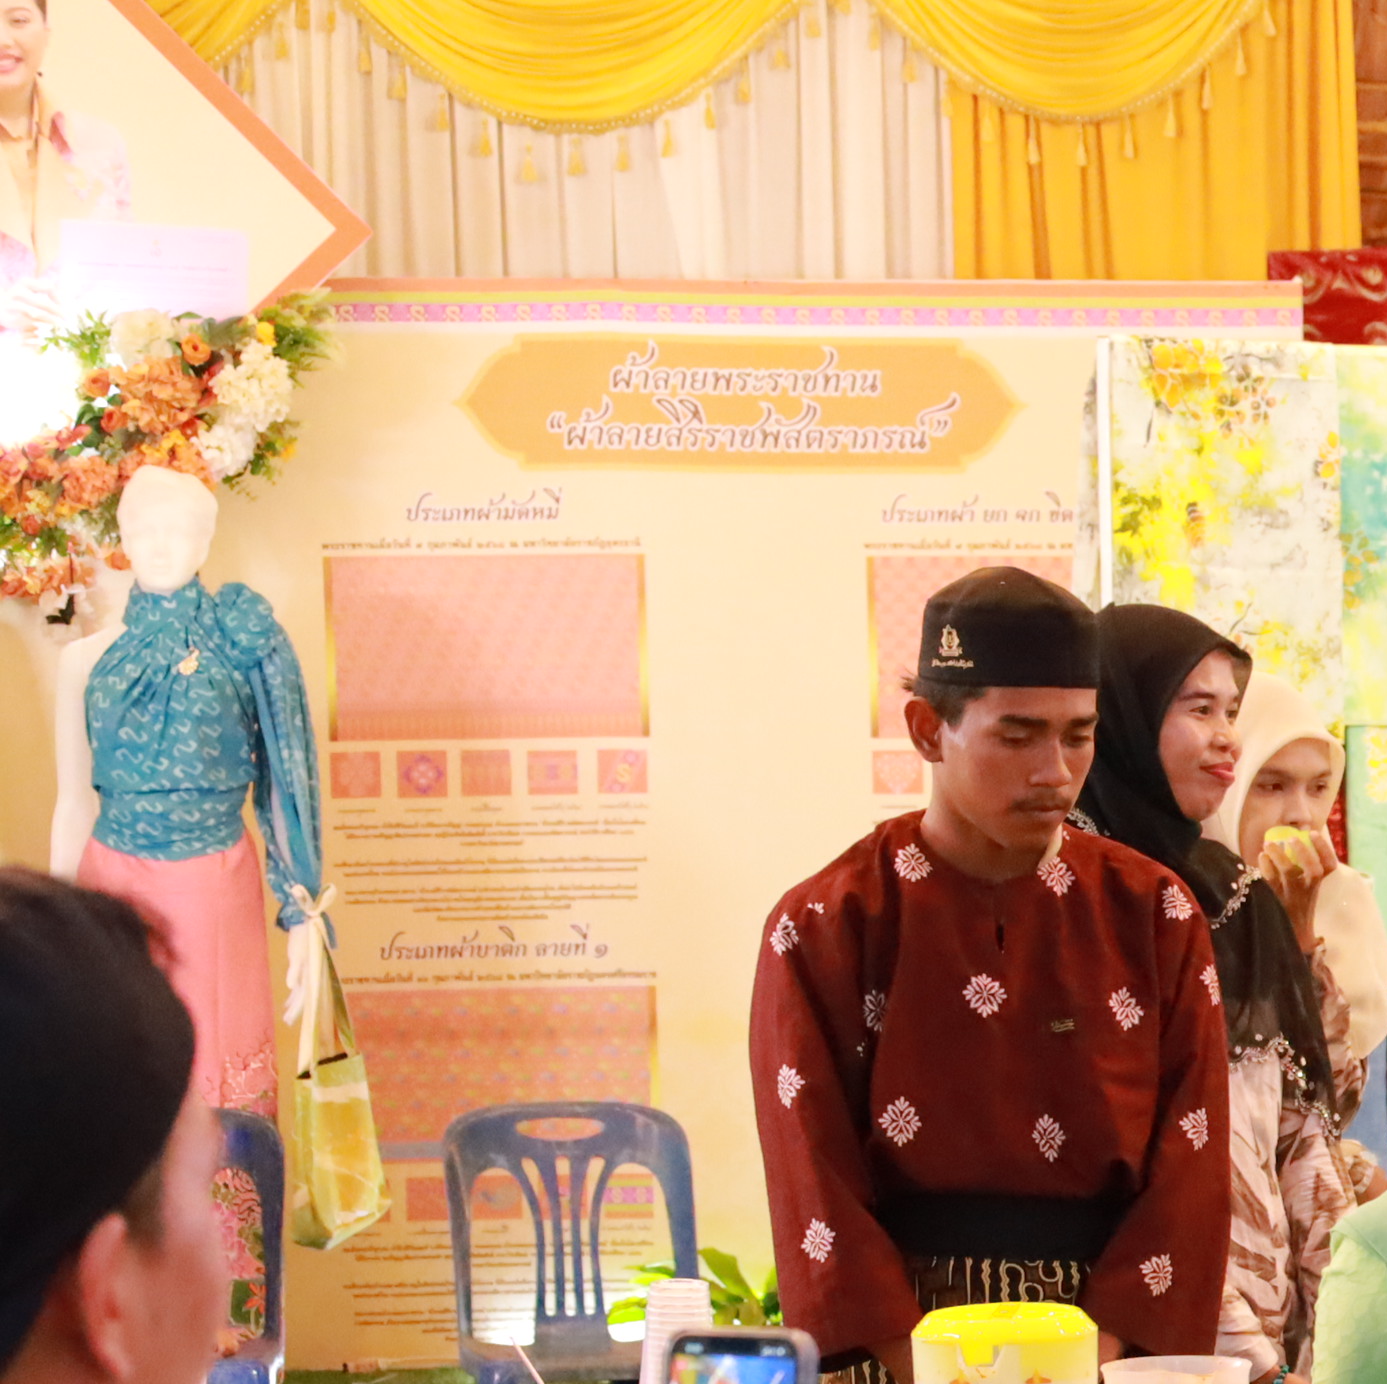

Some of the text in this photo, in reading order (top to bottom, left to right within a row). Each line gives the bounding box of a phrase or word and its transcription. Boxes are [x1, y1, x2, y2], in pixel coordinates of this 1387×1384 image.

[611, 342, 879, 395] ผ้าลายพระราชทาน
